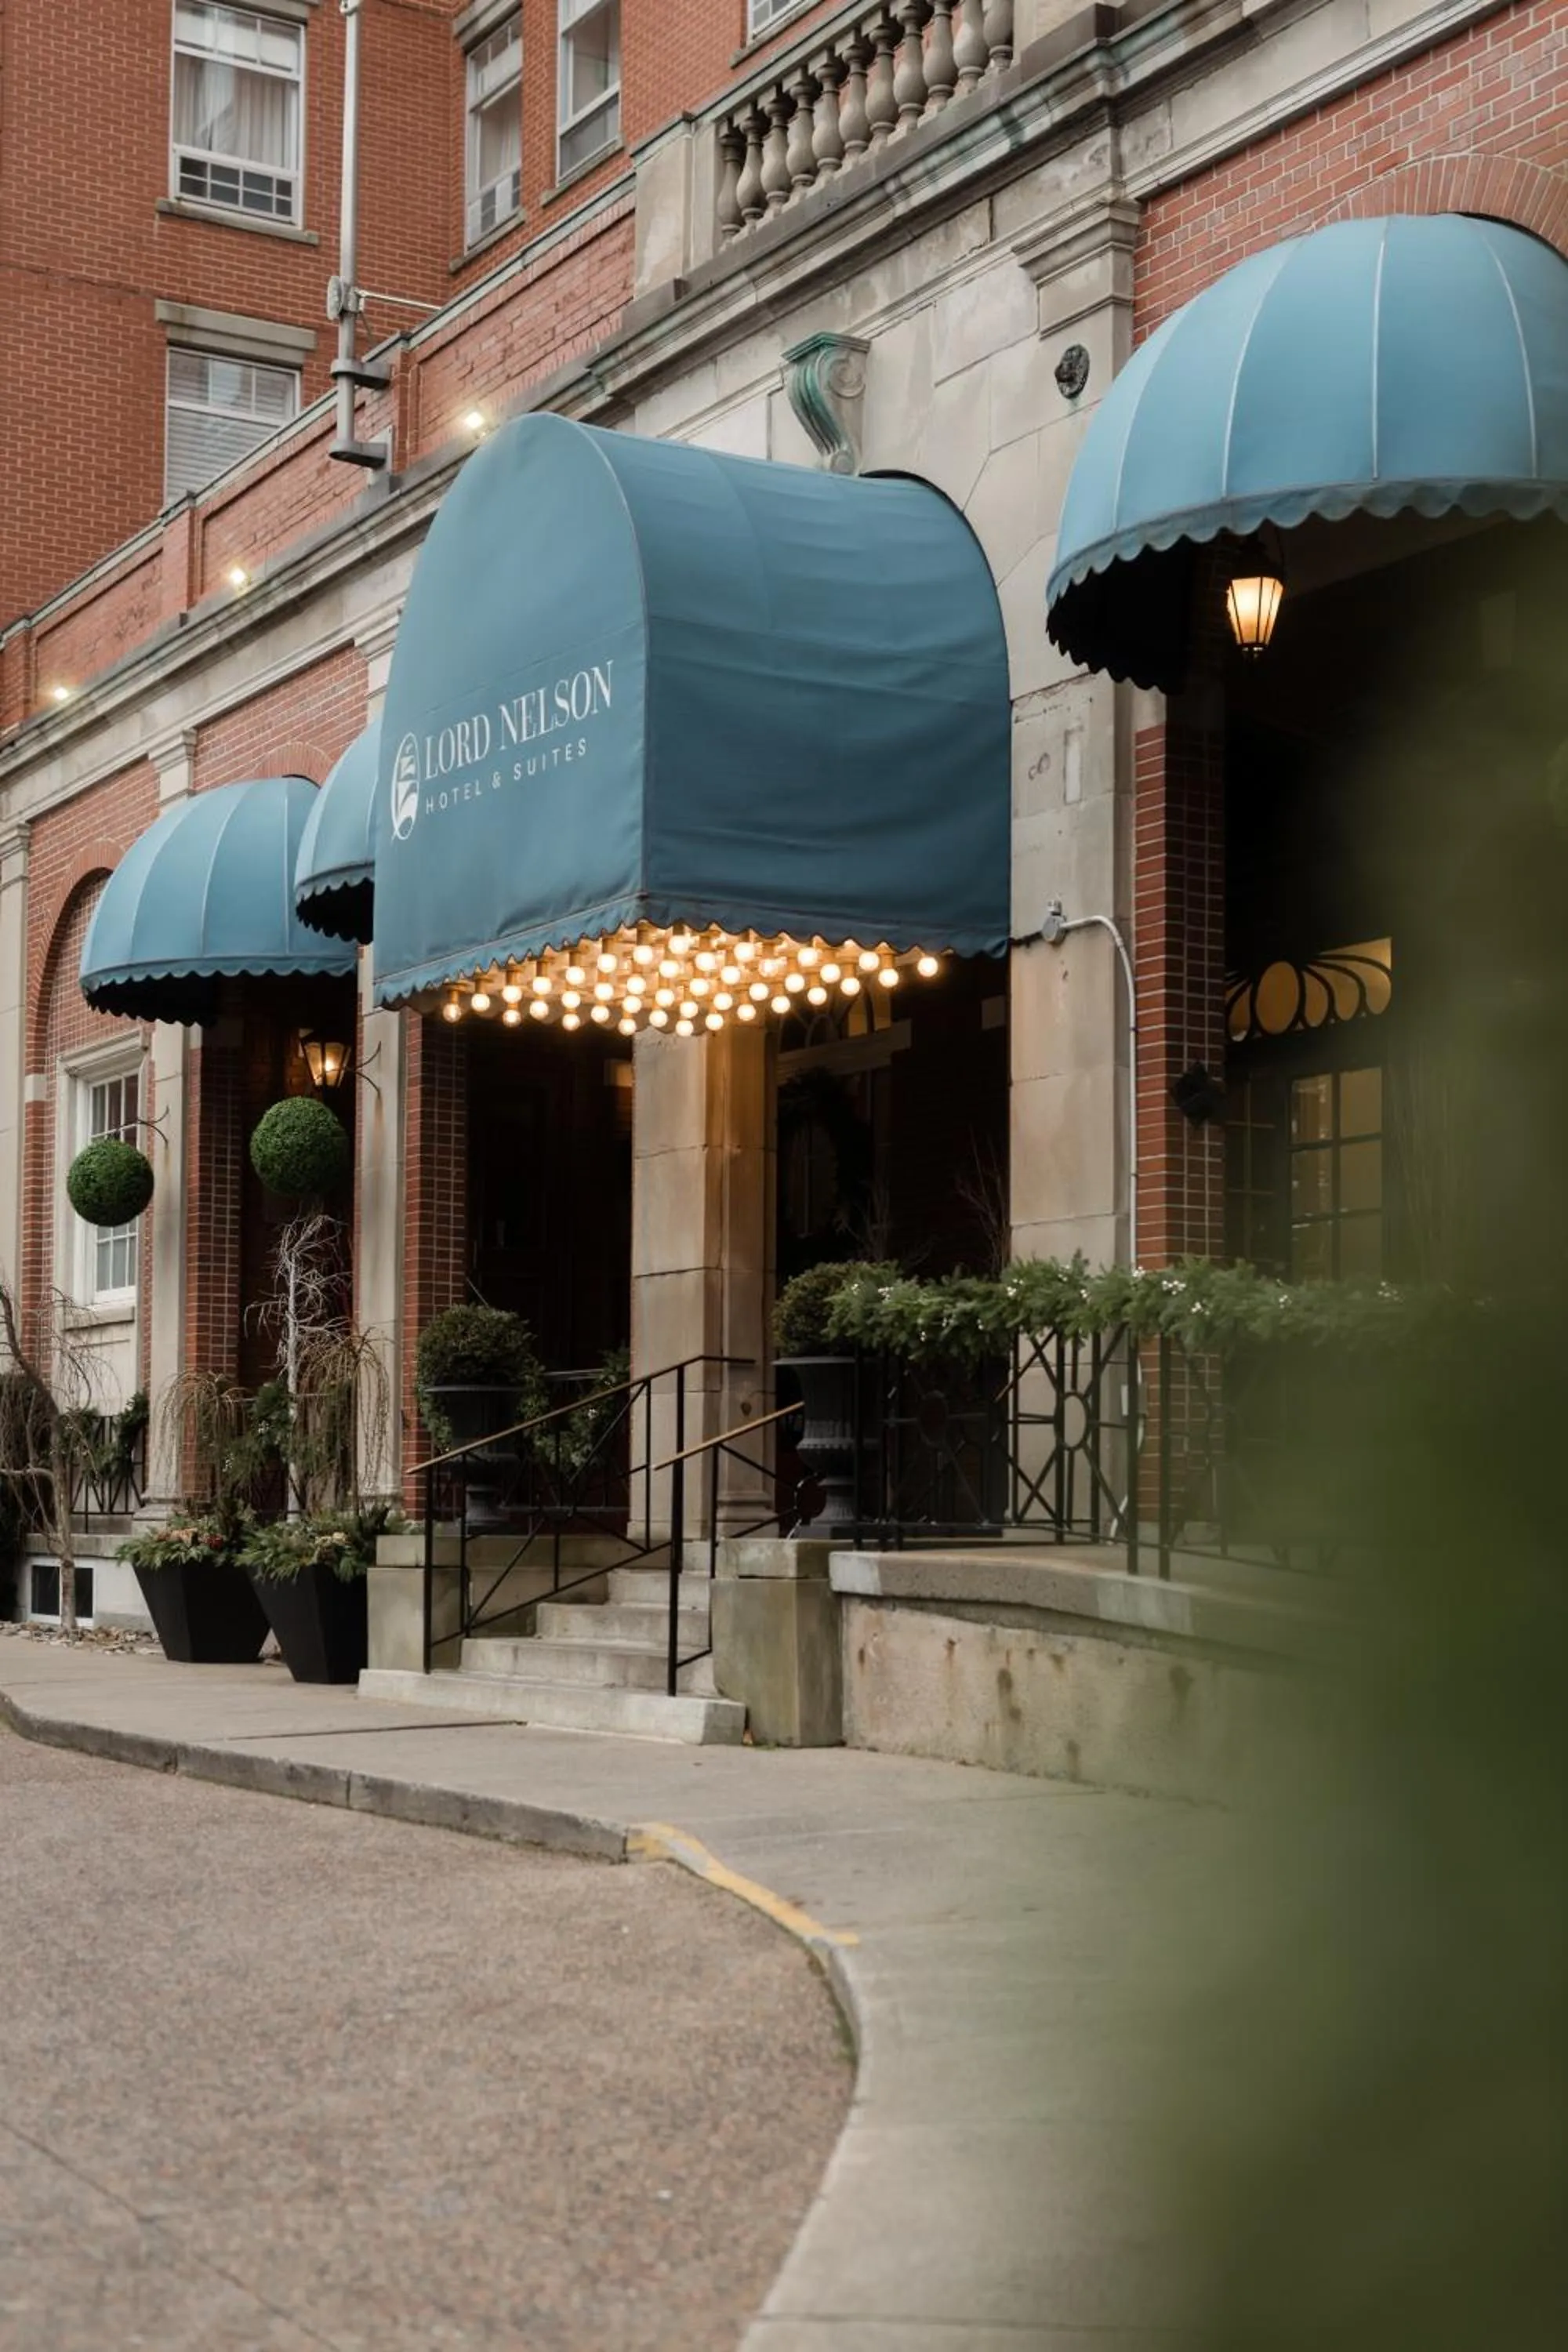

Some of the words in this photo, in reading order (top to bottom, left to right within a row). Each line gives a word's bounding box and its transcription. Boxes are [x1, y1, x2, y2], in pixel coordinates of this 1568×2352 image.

[424, 714, 491, 781] LORD
[498, 659, 614, 751] NELSON
[425, 779, 482, 815] HOTEL
[491, 771, 502, 789] &
[513, 737, 588, 781] SUITES
